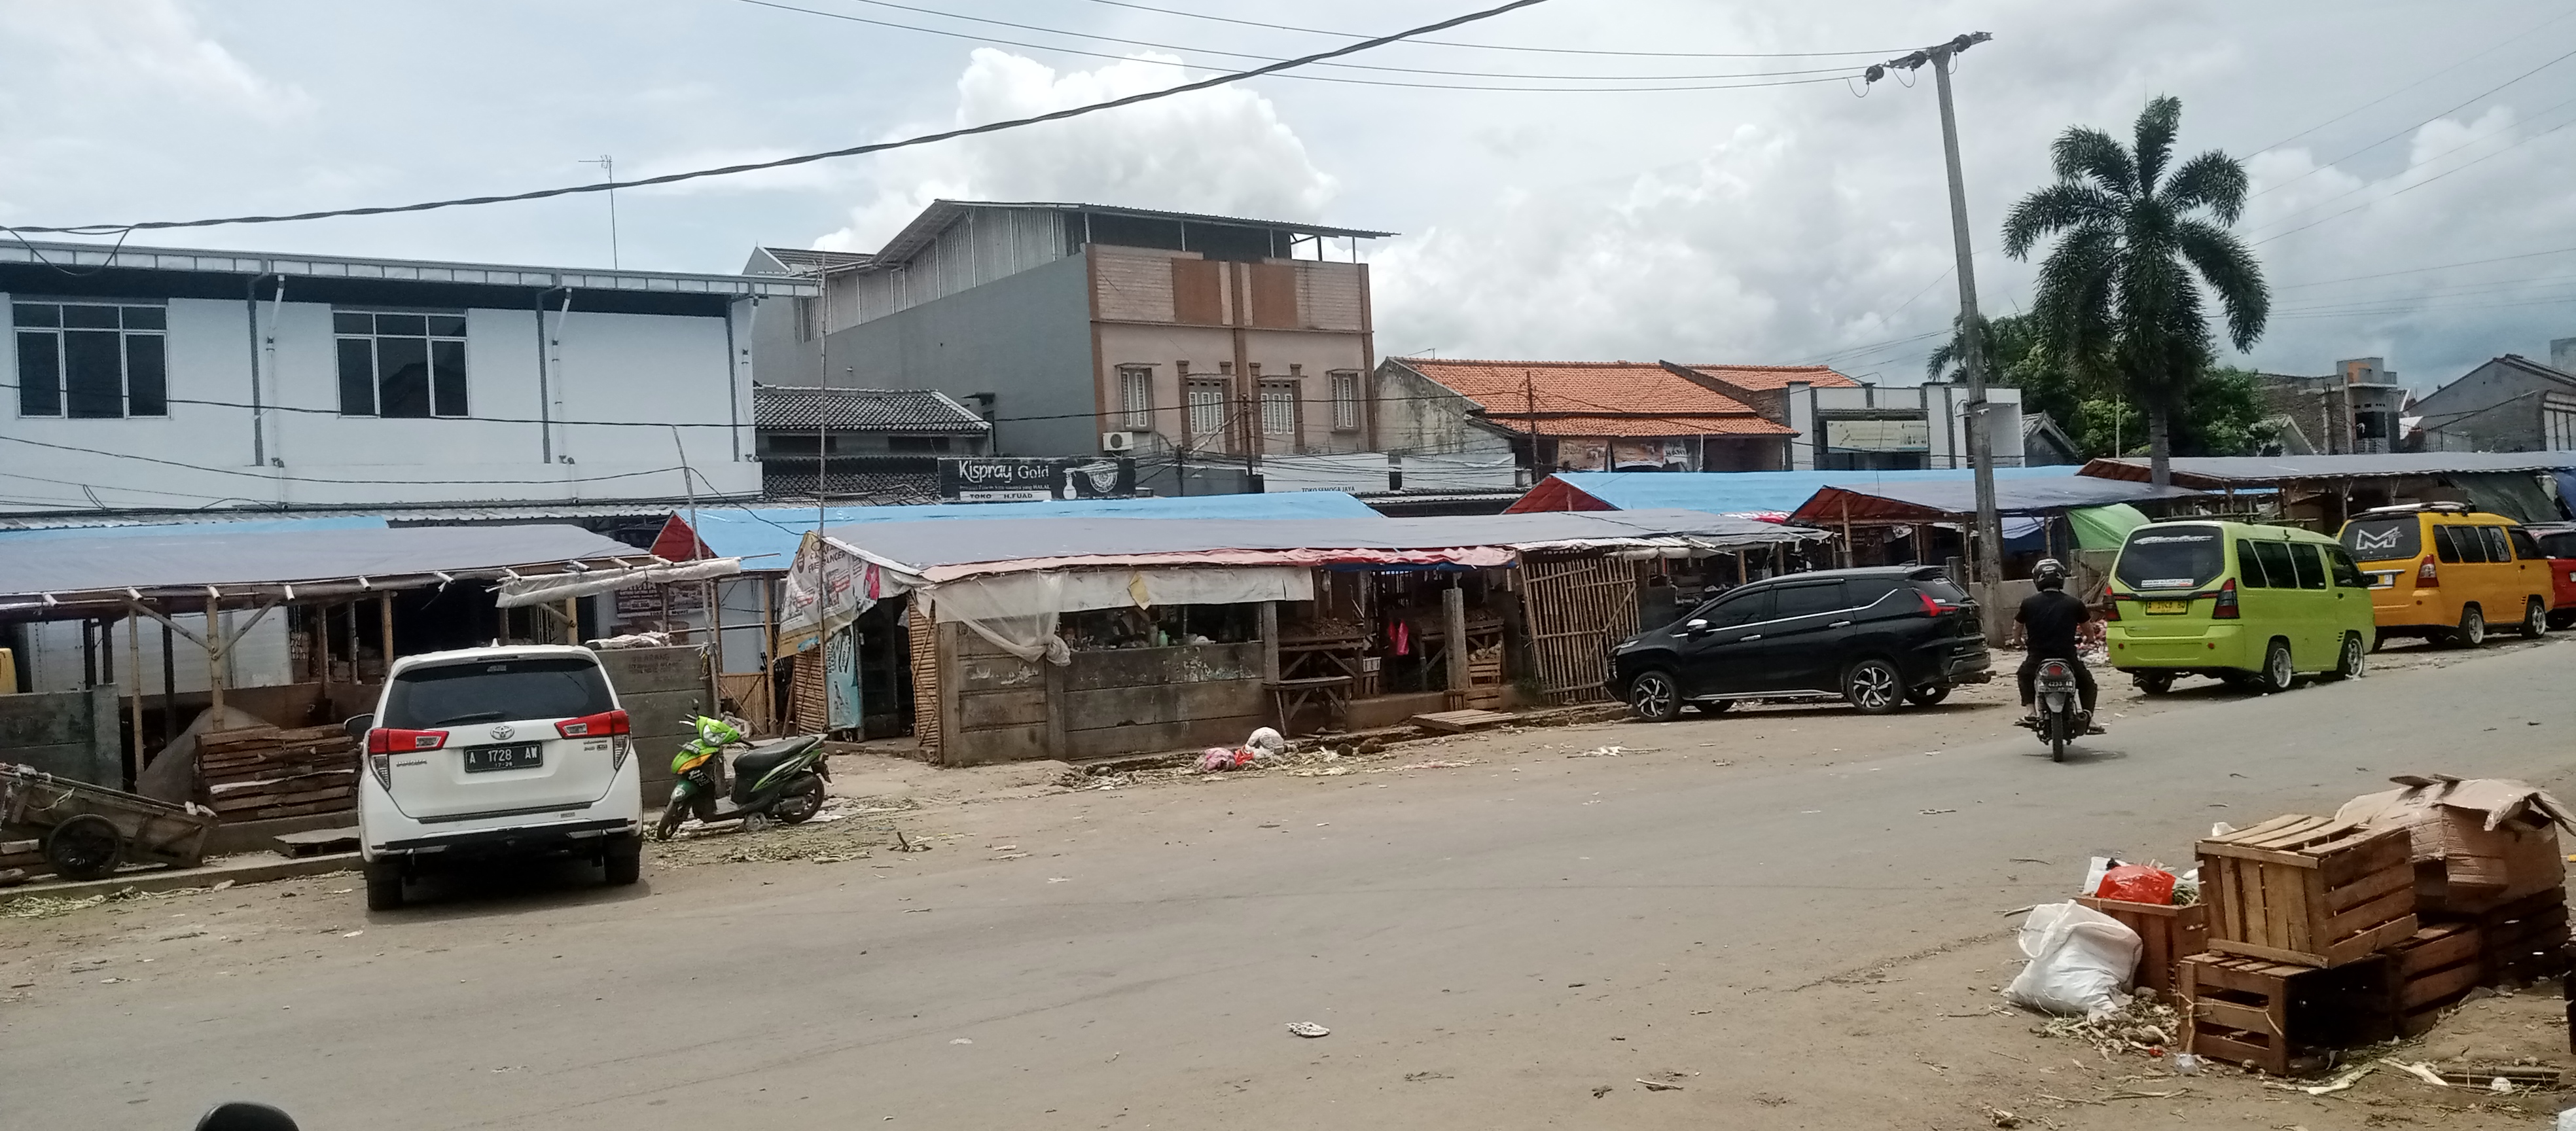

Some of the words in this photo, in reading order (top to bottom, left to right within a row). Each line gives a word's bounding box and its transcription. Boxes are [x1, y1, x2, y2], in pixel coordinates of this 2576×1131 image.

[959, 460, 1012, 483] Kispray
[1018, 465, 1049, 478] Gold
[469, 751, 476, 764] A
[488, 749, 512, 762] 1728
[525, 746, 537, 759] AW
